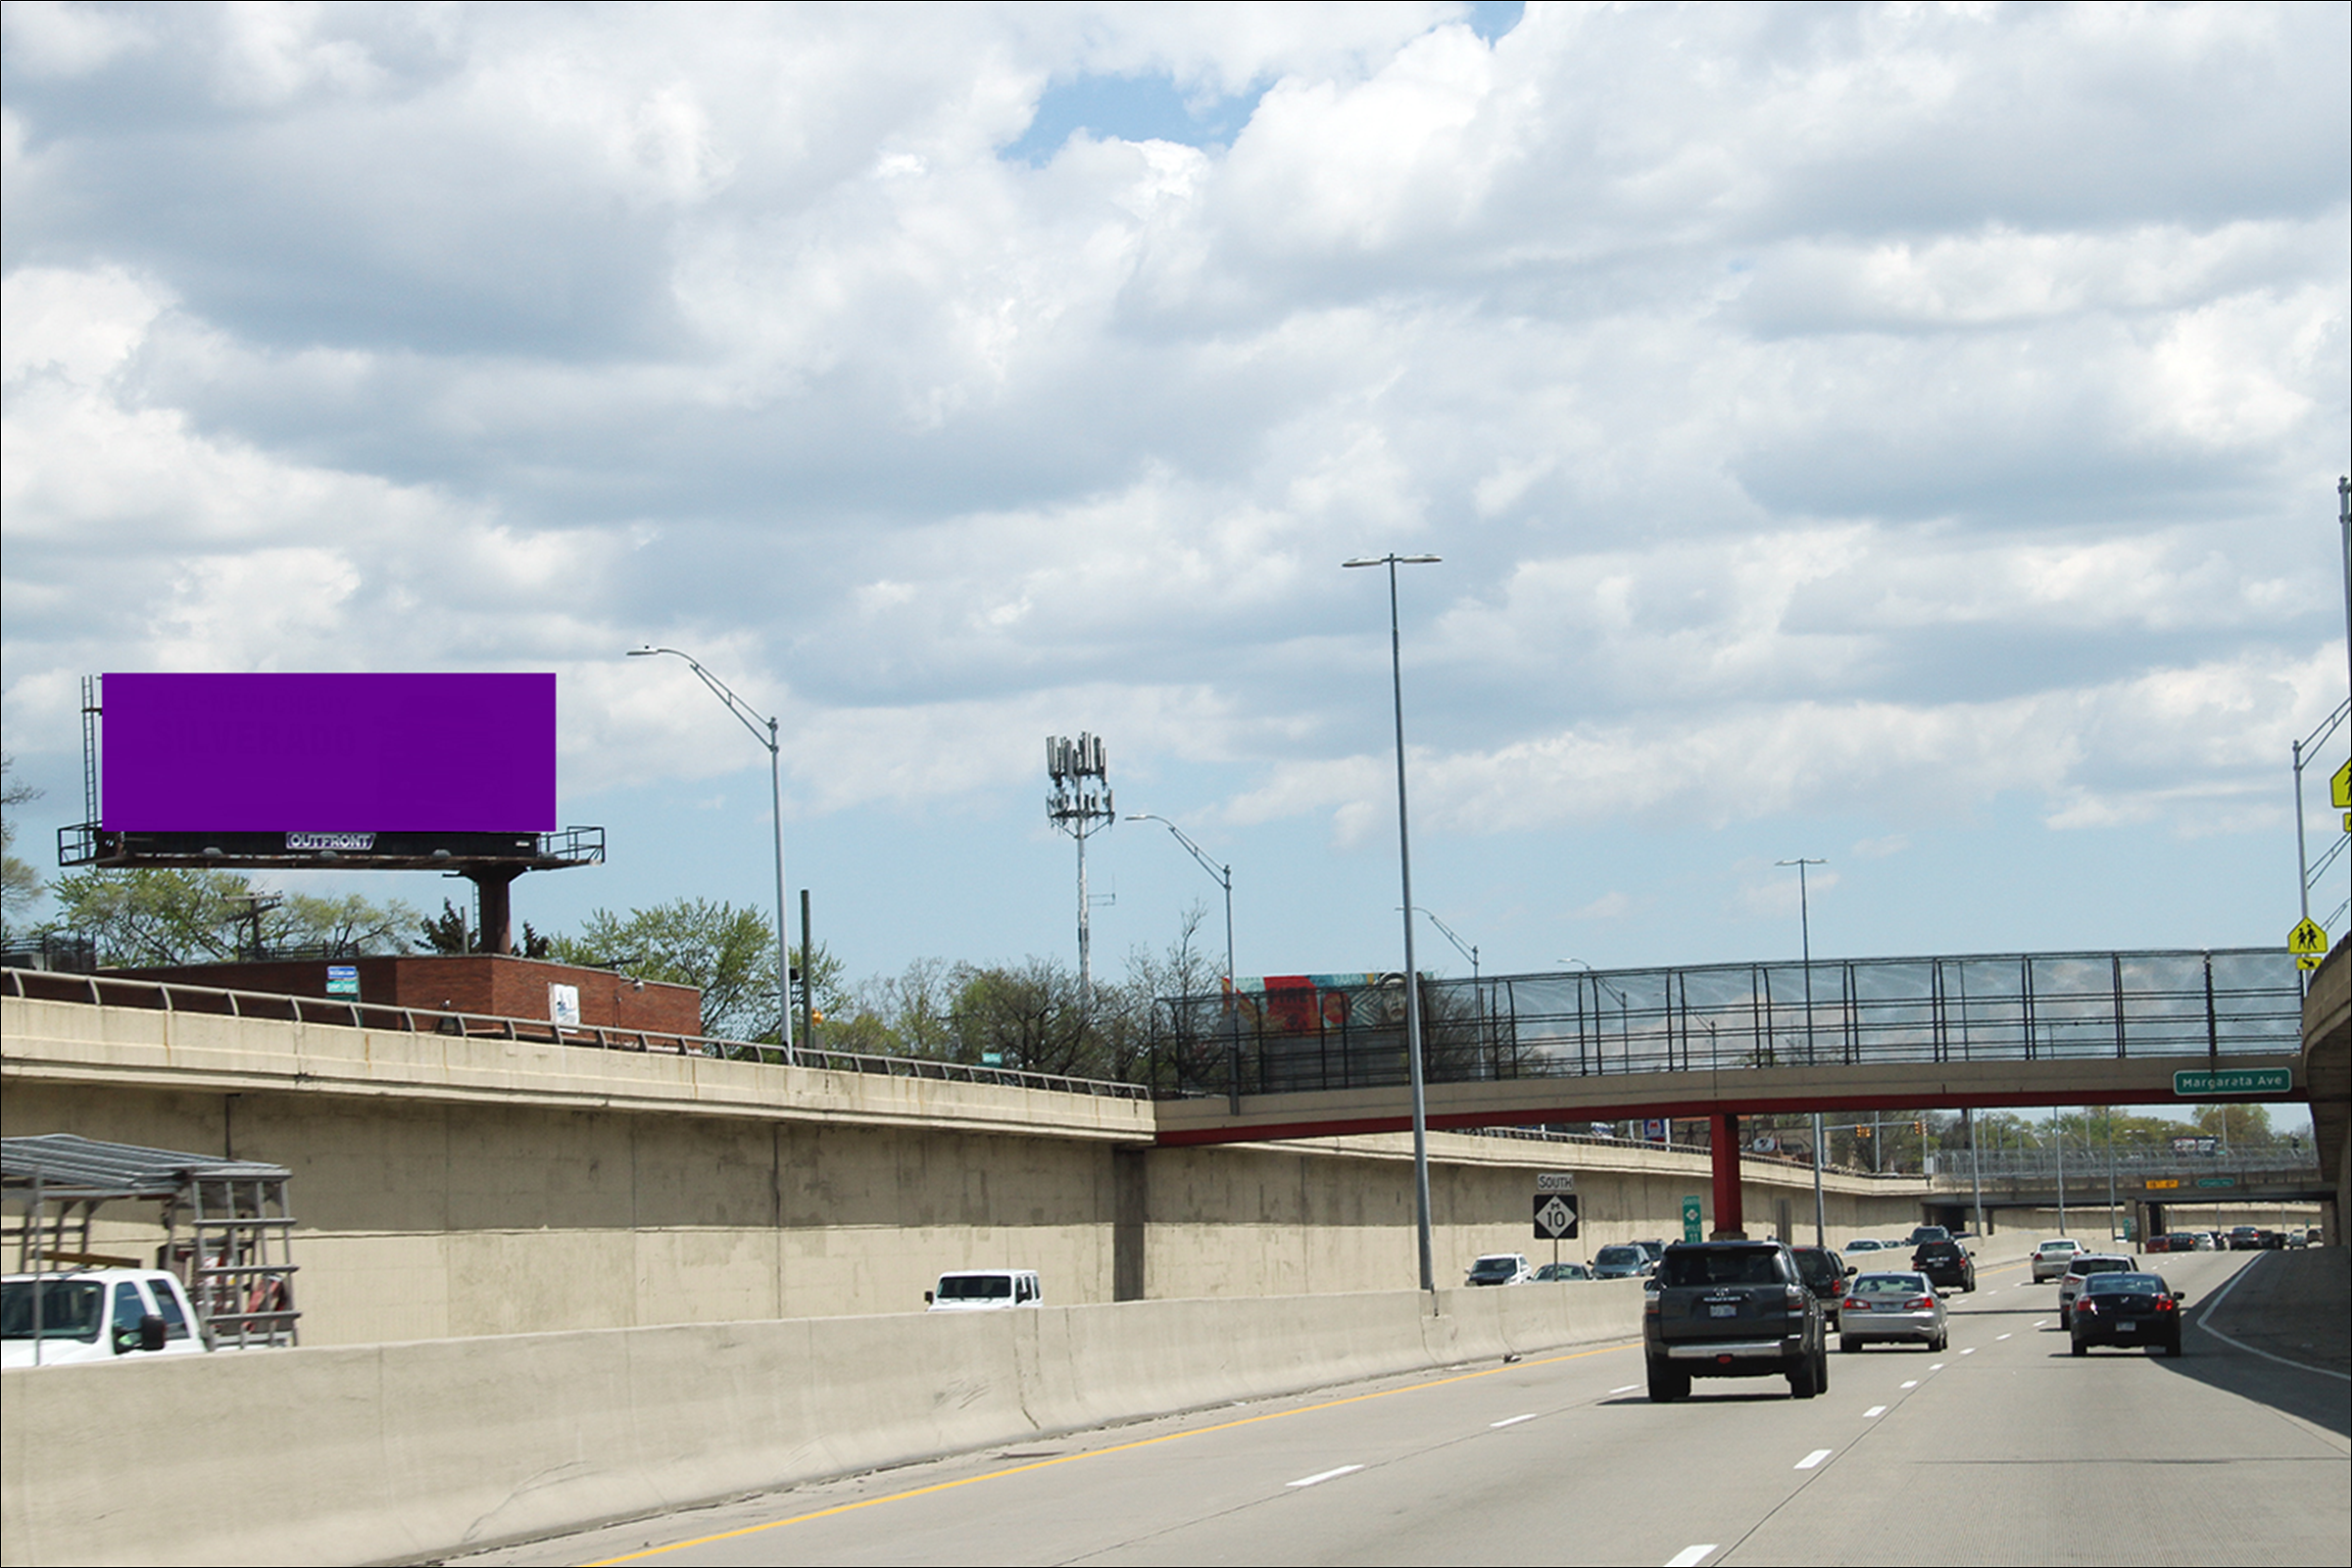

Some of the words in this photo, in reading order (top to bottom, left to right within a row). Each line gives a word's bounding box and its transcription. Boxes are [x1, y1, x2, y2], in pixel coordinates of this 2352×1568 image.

[291, 834, 370, 848] OUTFRONT
[2182, 1077, 2253, 1090] Margarata
[2257, 1076, 2283, 1086] Ave
[1539, 1175, 1573, 1189] SOUTH
[1550, 1201, 1560, 1210] M
[1546, 1210, 1566, 1228] 10
